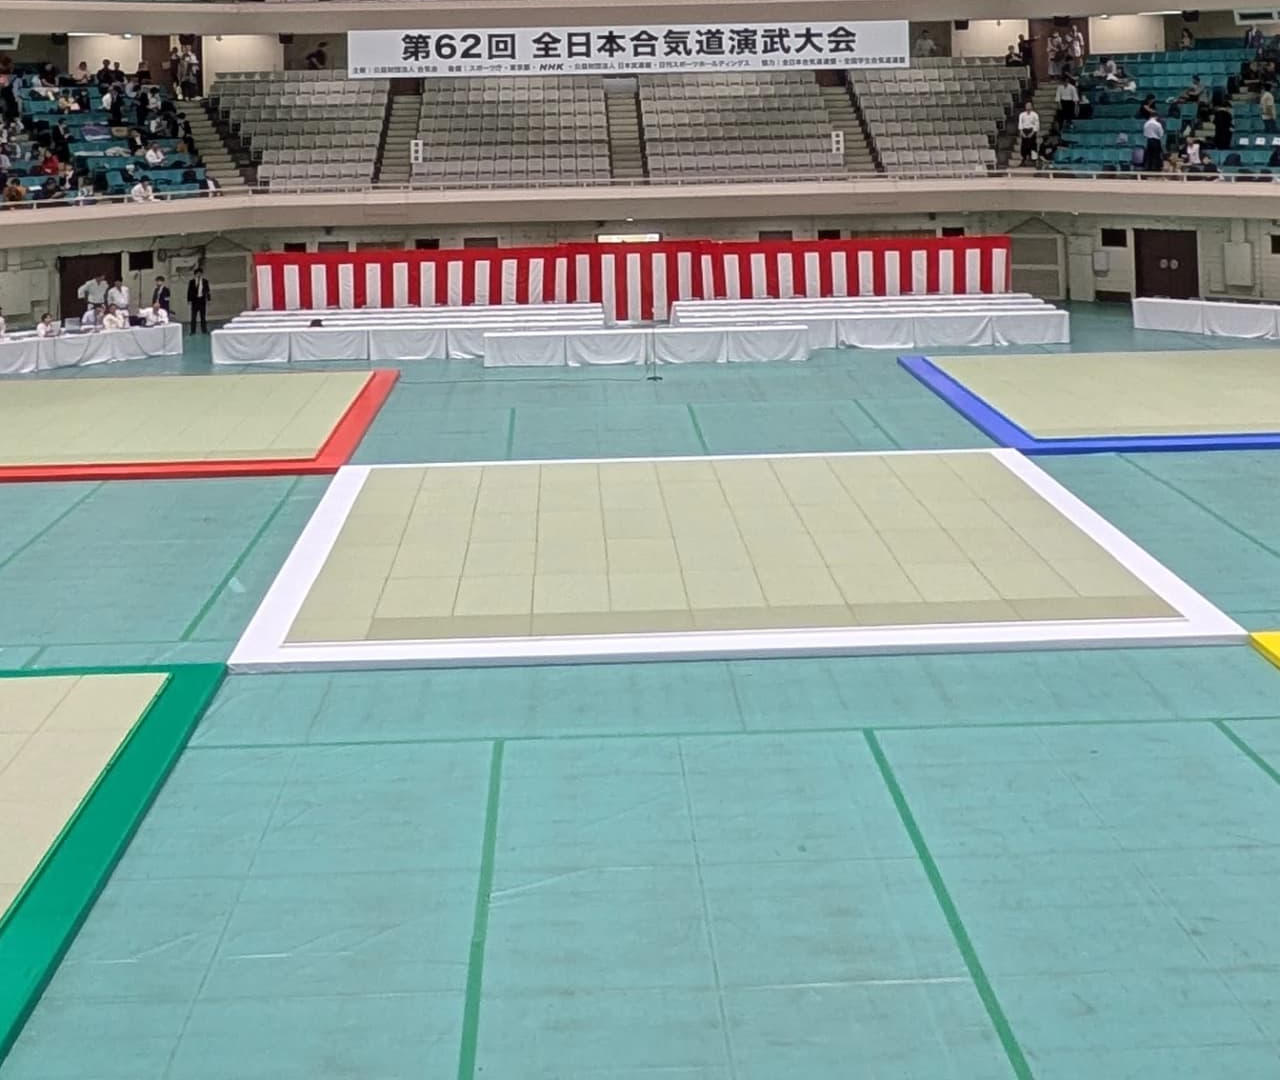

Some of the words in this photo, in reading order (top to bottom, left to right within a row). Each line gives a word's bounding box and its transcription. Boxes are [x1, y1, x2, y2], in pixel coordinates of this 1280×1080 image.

[401, 33, 516, 61] 第62回
[532, 26, 857, 59] 全日本合気道演武大会
[539, 63, 565, 71] NHK
